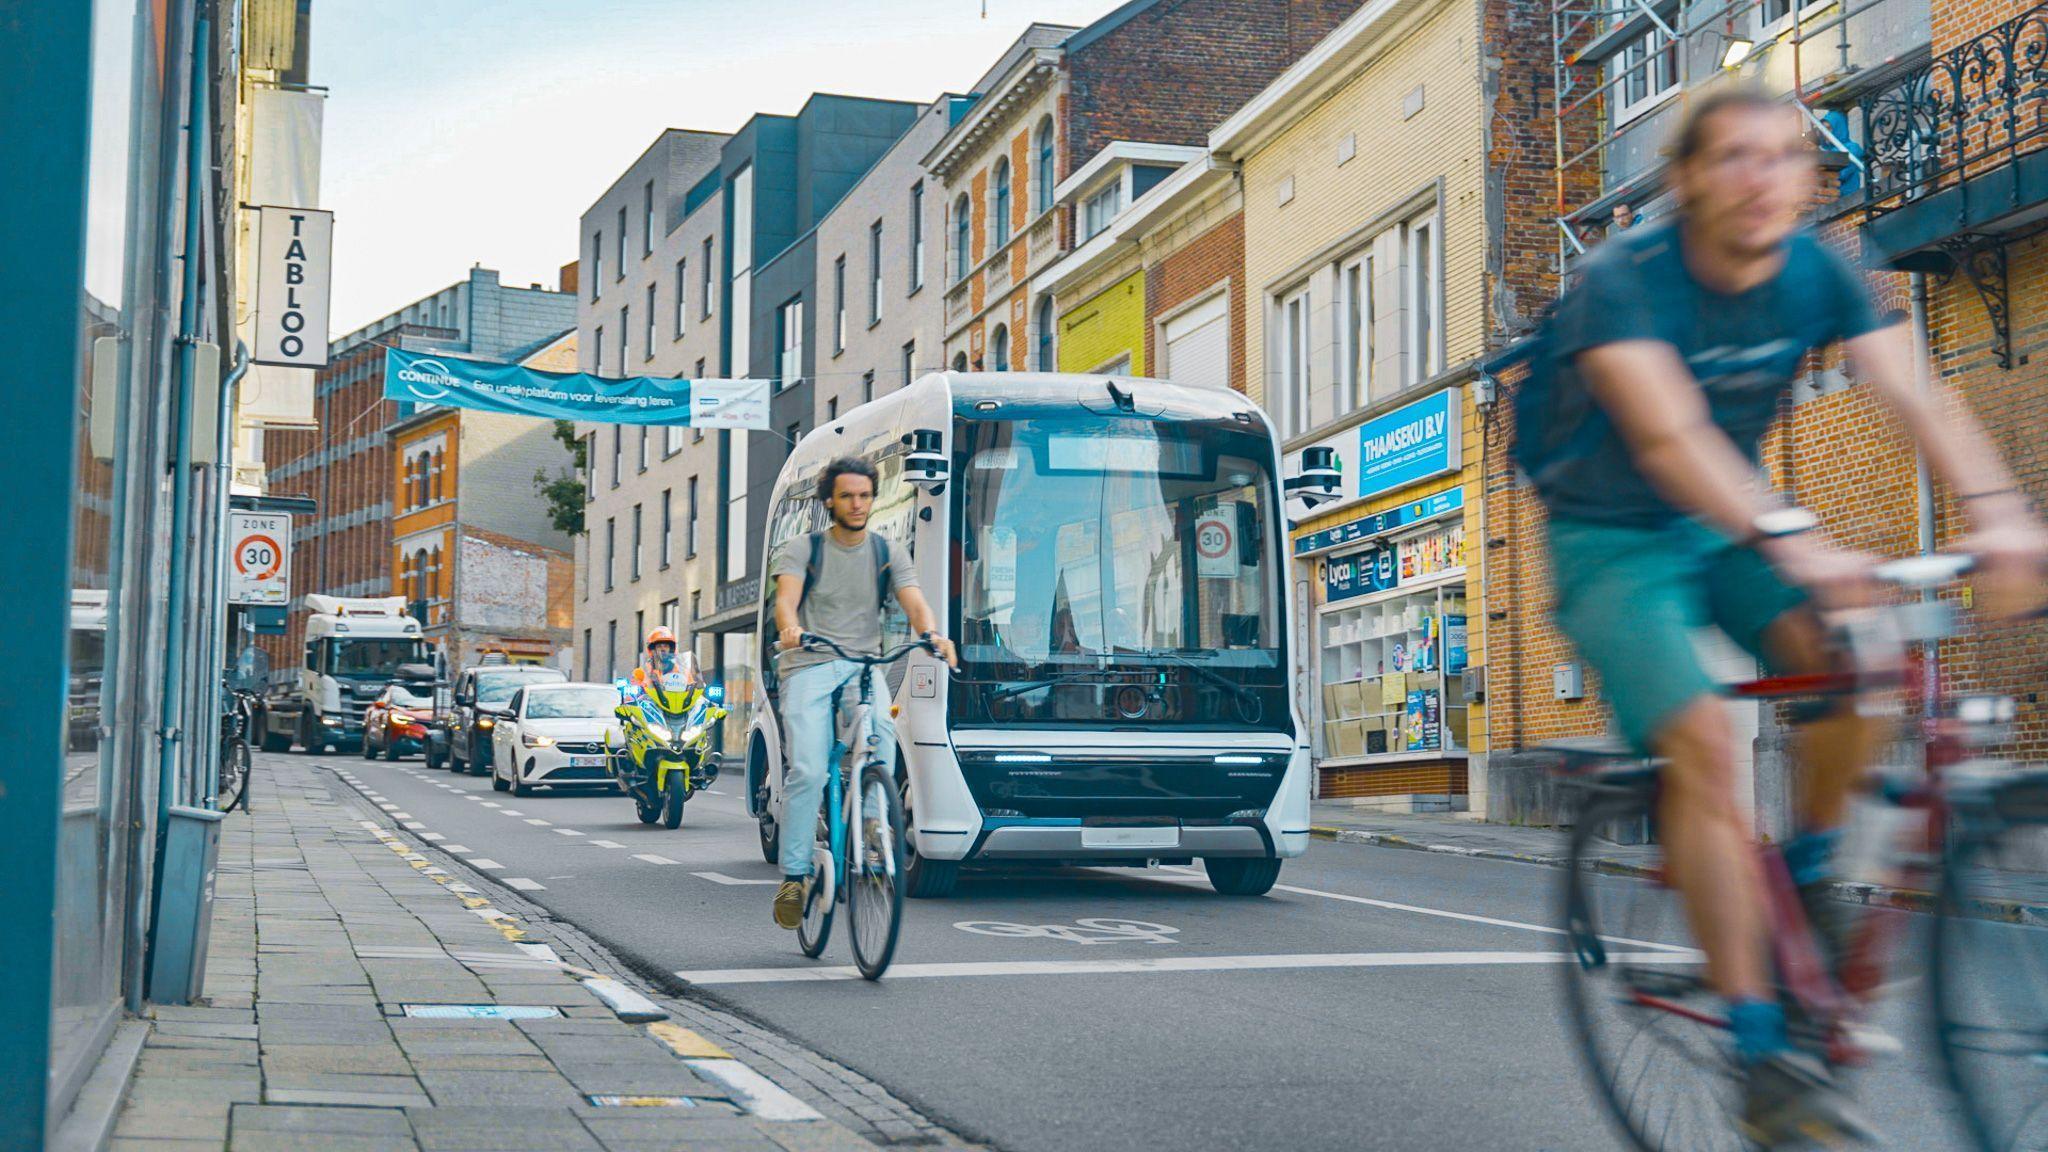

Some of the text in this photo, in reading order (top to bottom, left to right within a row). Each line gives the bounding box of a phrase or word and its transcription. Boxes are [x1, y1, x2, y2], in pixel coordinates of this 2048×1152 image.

[280, 215, 306, 358] TABLOO
[398, 369, 461, 388] CONTINUE
[473, 380, 494, 392] Een
[526, 386, 568, 401] platform
[569, 392, 593, 403] voor
[594, 393, 647, 408] levenslang
[1363, 419, 1424, 462] THAMSEKU
[243, 520, 276, 529] ZONE
[1201, 532, 1224, 546] 30
[246, 549, 271, 565] 30
[1329, 563, 1350, 587] Lyca
